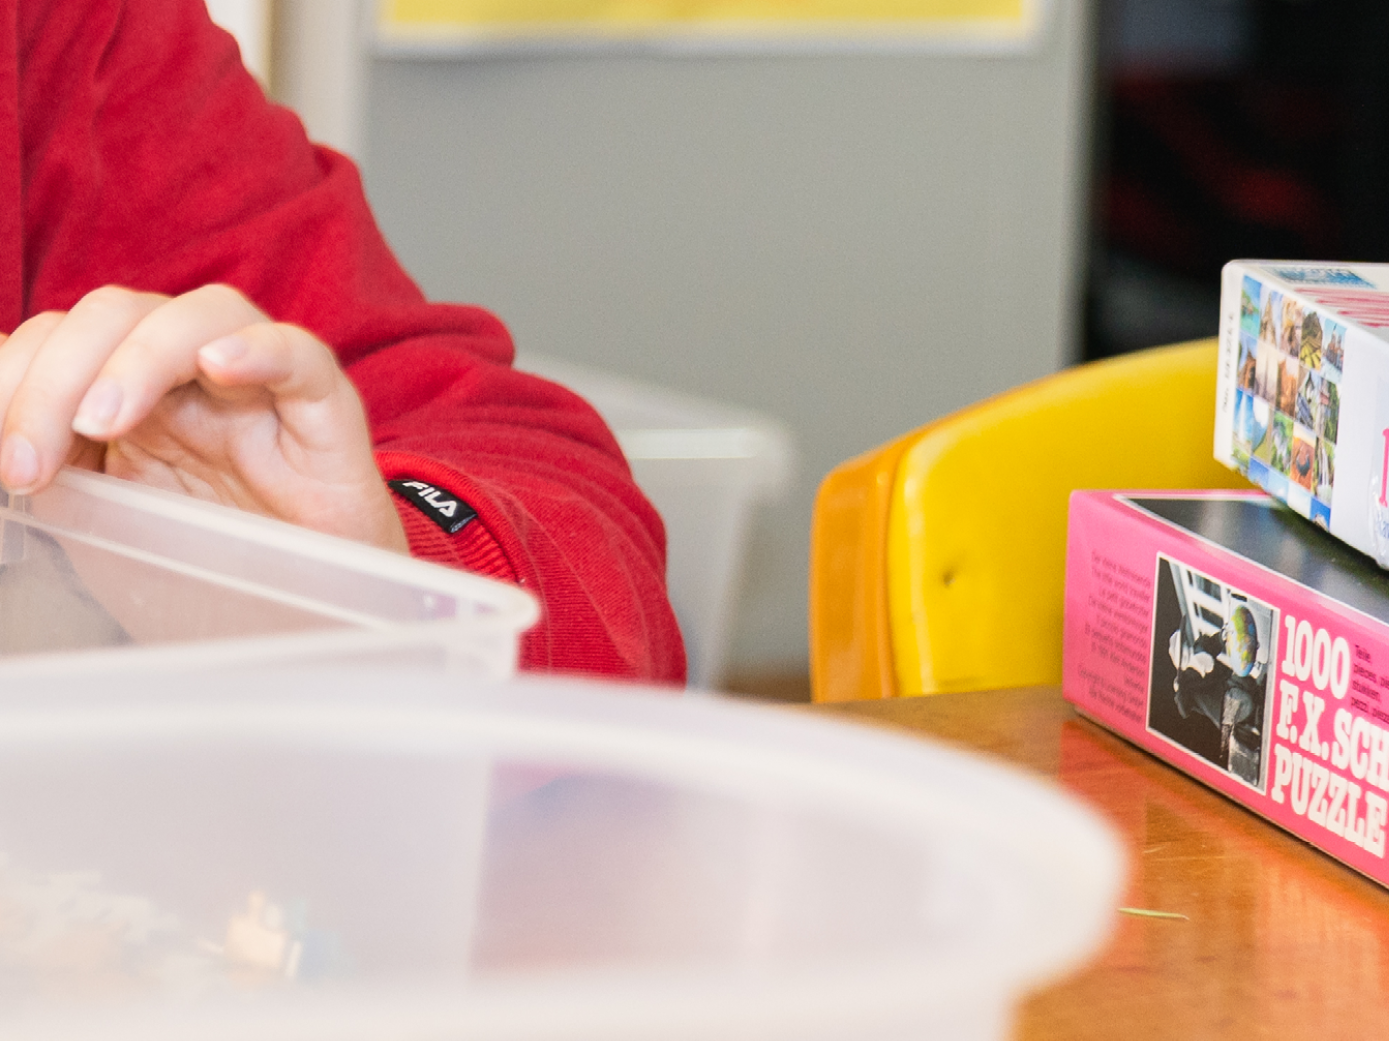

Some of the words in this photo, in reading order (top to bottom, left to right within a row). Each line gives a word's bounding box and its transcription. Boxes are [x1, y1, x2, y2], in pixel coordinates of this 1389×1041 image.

[402, 481, 458, 518] FILA
[1281, 615, 1351, 700] 1000
[1271, 743, 1388, 859] PUZZLE
